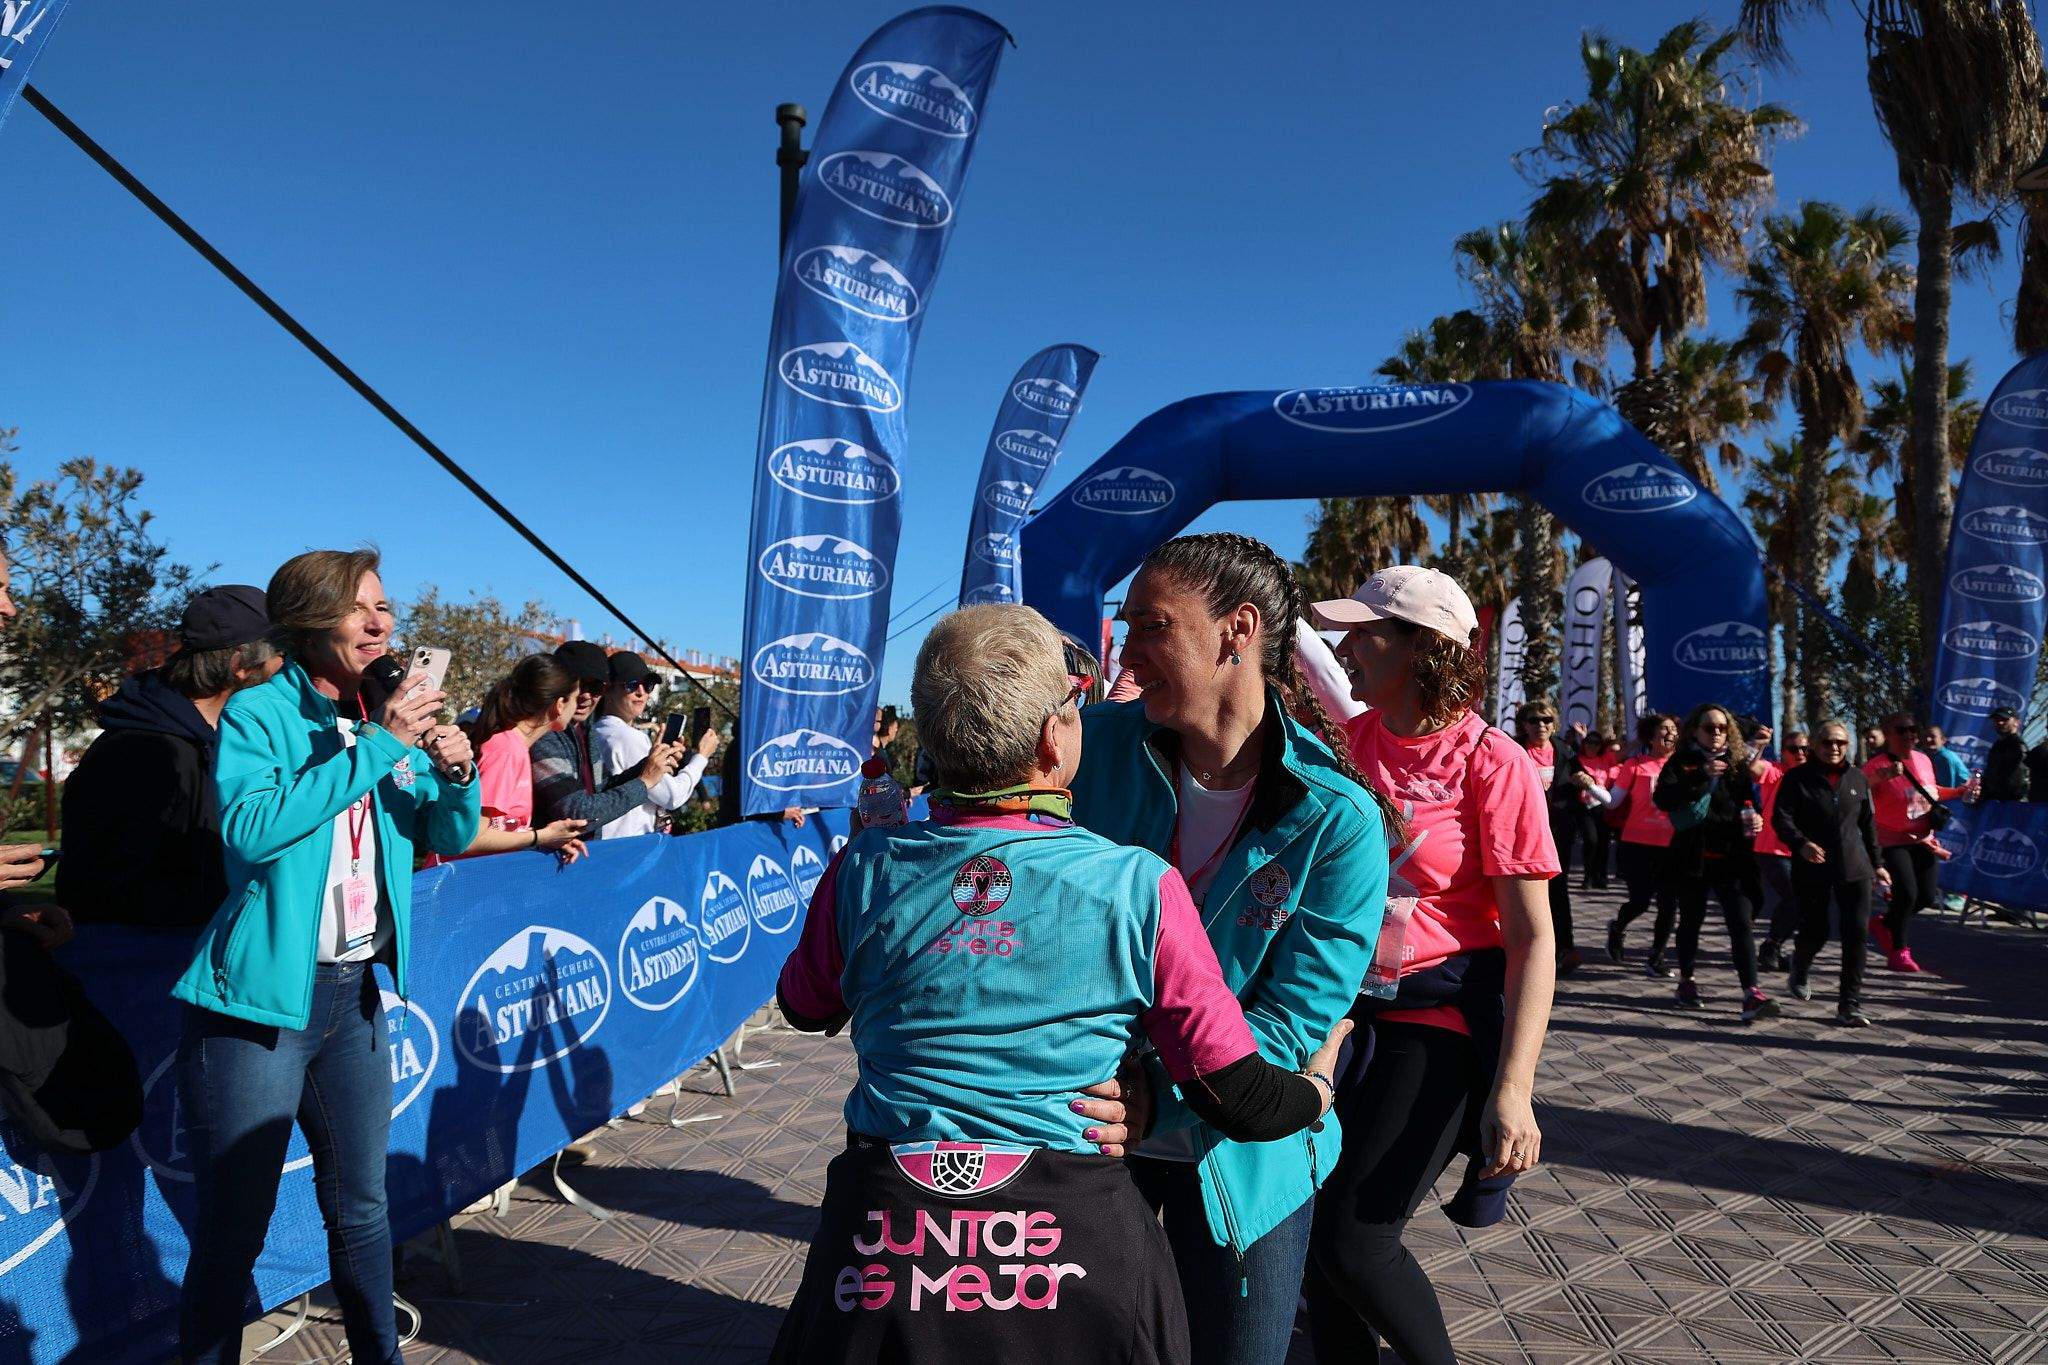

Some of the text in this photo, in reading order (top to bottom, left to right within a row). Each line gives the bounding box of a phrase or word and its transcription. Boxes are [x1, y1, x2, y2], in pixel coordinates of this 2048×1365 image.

[858, 71, 967, 134] ASTURIANA
[826, 161, 939, 224] ASTURIANA
[803, 256, 907, 317] ASTURIANA
[788, 356, 894, 408] ASTURIANA
[1291, 388, 1460, 416] ASTURIANA
[777, 453, 890, 494] ASTURIANA
[1079, 486, 1168, 503] ASTURIANA
[1592, 484, 1692, 503] ASTURIANA
[768, 551, 878, 588] ASTURIANA
[760, 652, 865, 684] ASTURIANA
[781, 652, 863, 666] CENTRAL LECHERA
[1567, 586, 1600, 730] OYSHO
[751, 887, 797, 919] ASTURIANA
[948, 919, 1016, 938] UNTas
[494, 971, 549, 1000] CENTRAL
[472, 974, 605, 1054] ASTURIANA
